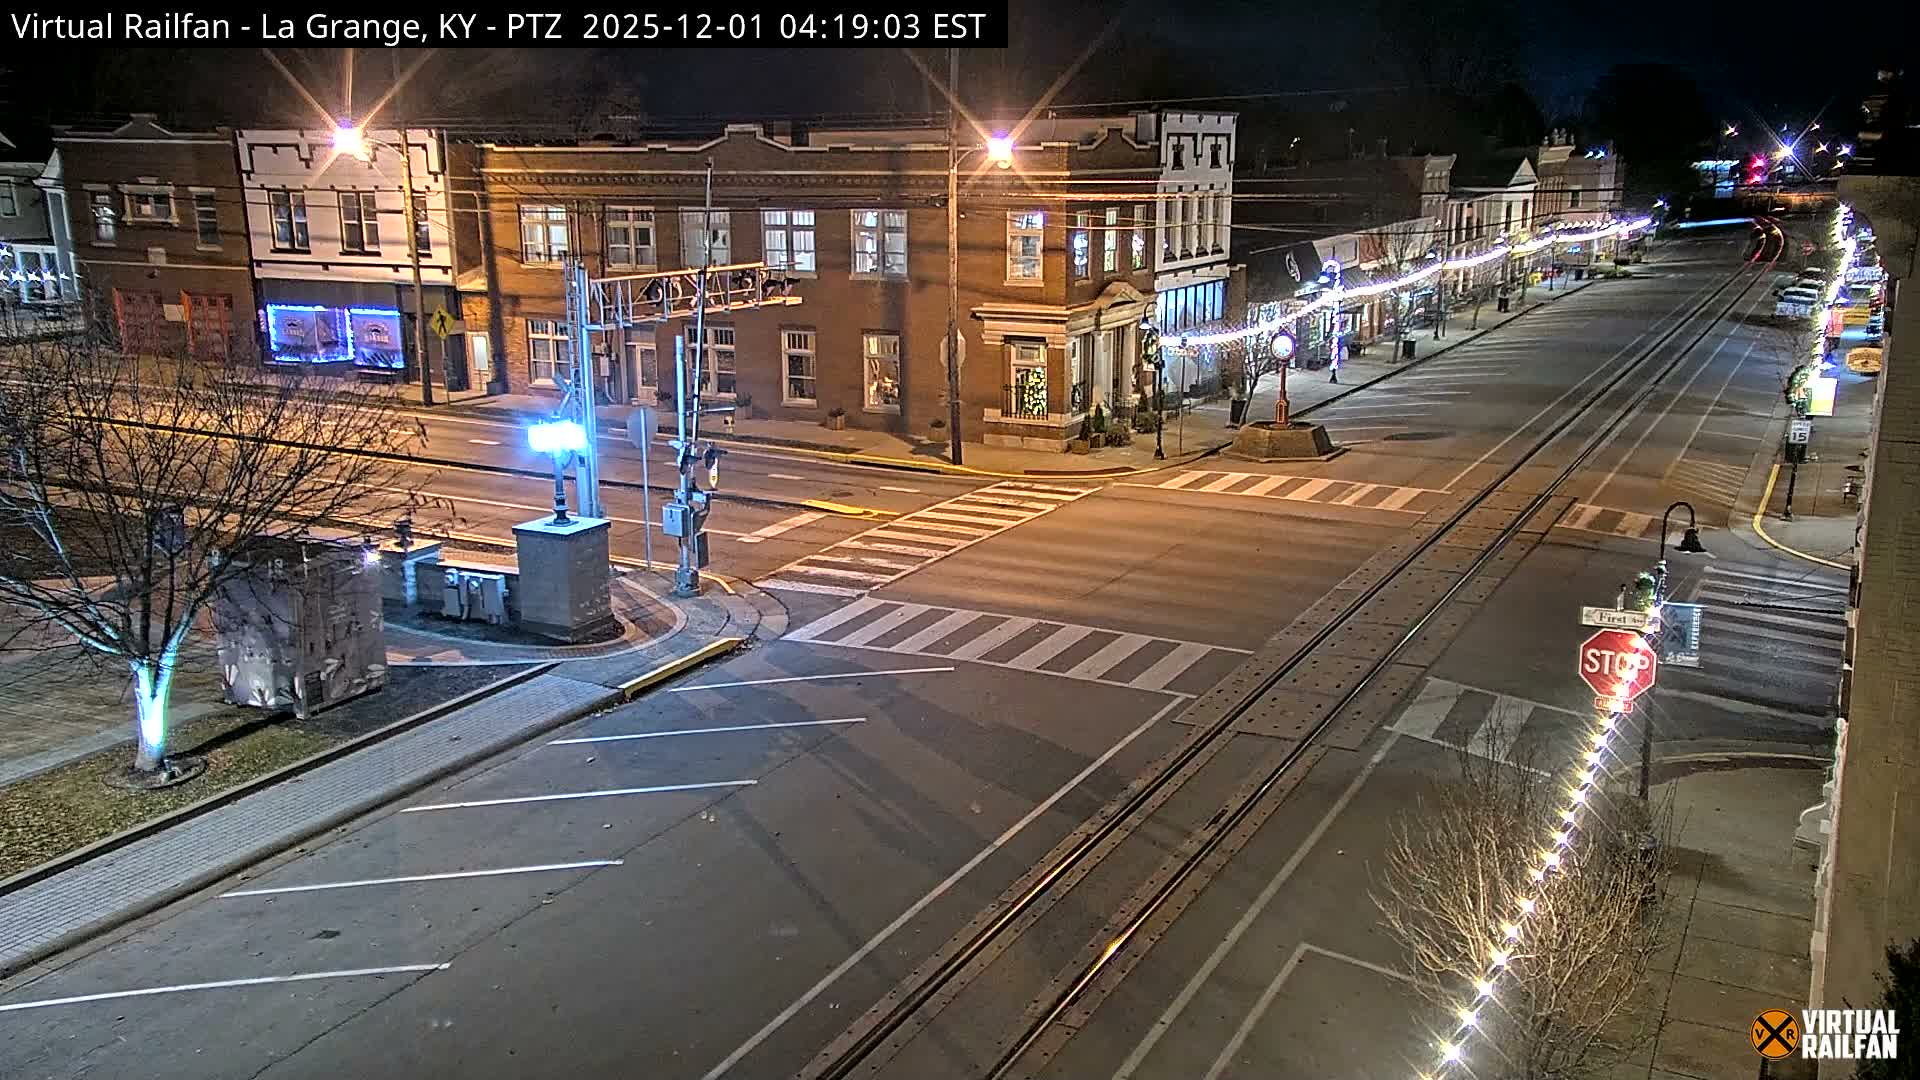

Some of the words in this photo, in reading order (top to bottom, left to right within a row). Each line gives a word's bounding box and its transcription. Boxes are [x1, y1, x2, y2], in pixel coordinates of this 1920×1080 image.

[1793, 432, 1807, 442] 15
[1600, 611, 1627, 624] First
[1584, 648, 1650, 676] STOP
